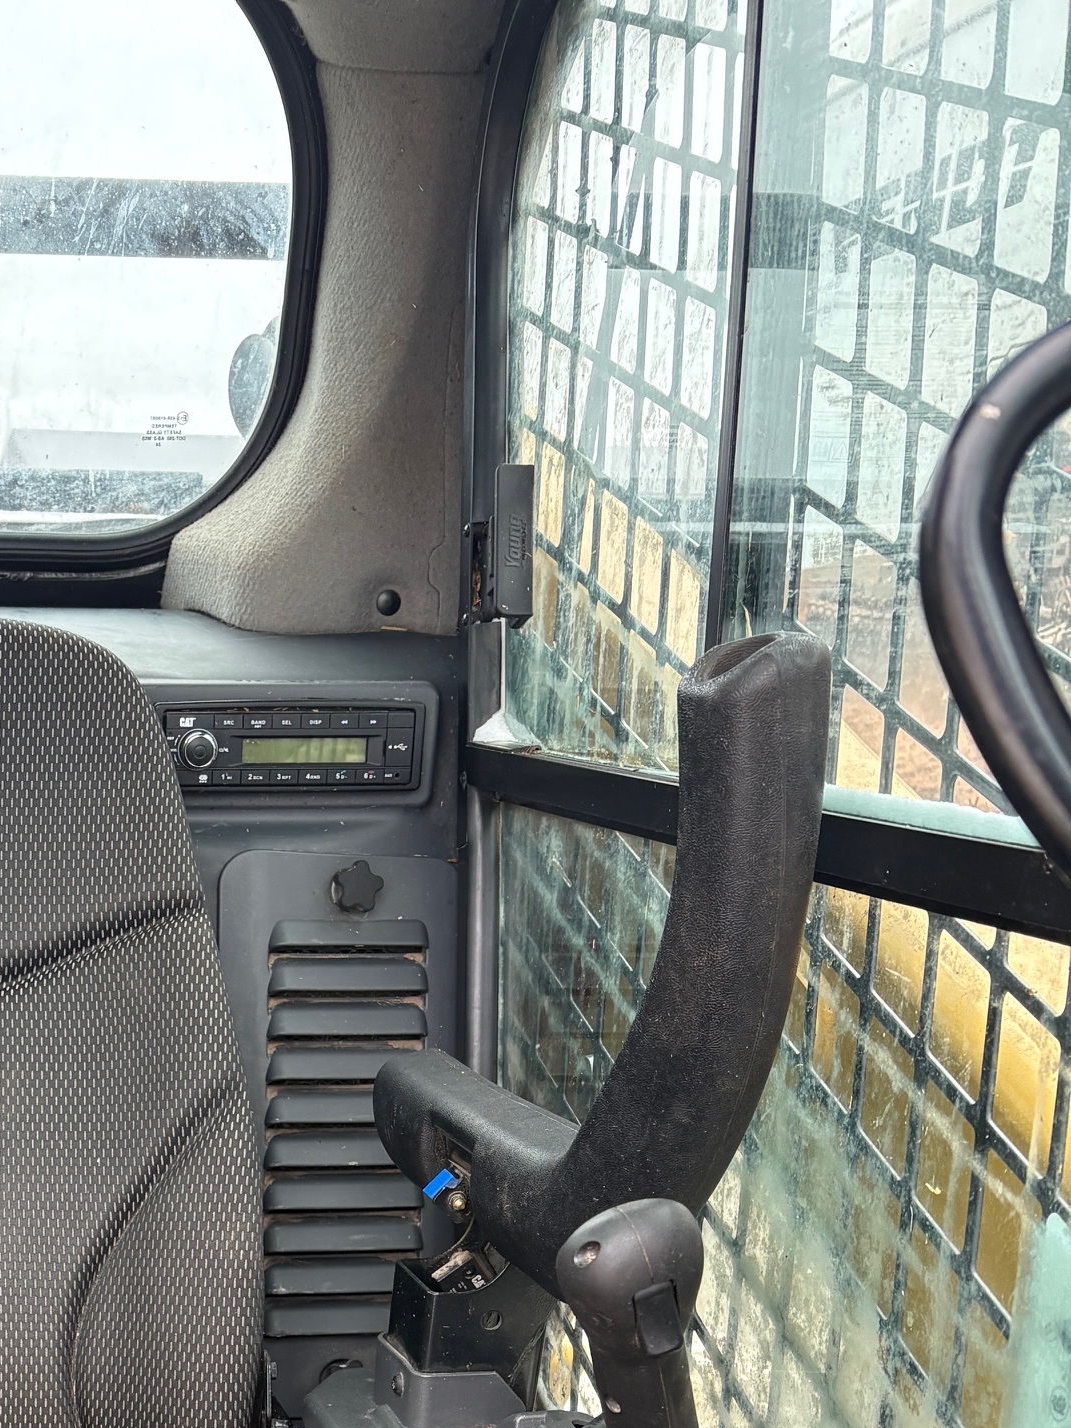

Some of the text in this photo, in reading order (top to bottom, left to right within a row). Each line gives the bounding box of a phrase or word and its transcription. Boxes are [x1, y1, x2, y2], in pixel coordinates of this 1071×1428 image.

[504, 514, 523, 568] Young
[179, 717, 196, 728] CAT
[471, 1274, 486, 1289] CA
